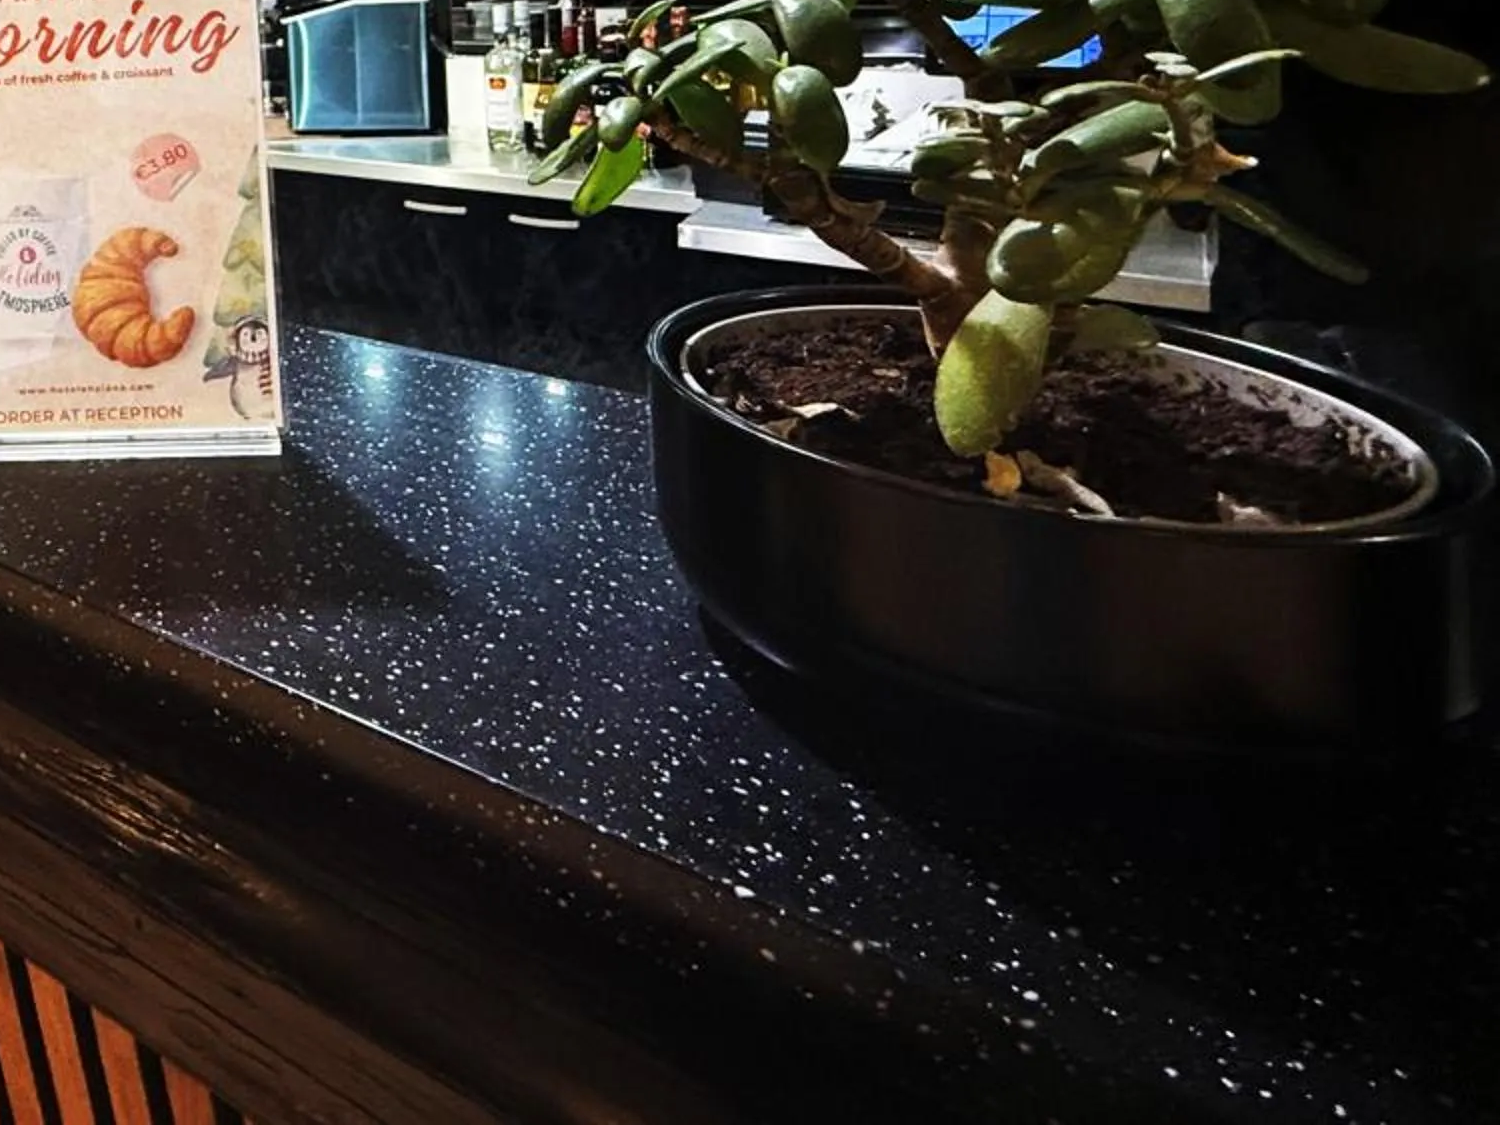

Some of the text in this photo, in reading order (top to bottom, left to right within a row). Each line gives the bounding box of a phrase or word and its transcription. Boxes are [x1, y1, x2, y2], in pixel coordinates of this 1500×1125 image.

[3, 75, 17, 87] of
[20, 73, 53, 86] fresh
[56, 70, 97, 84] coffee
[113, 66, 174, 80] croissant
[59, 409, 81, 422] AT
[84, 405, 184, 422] RECEPTION
